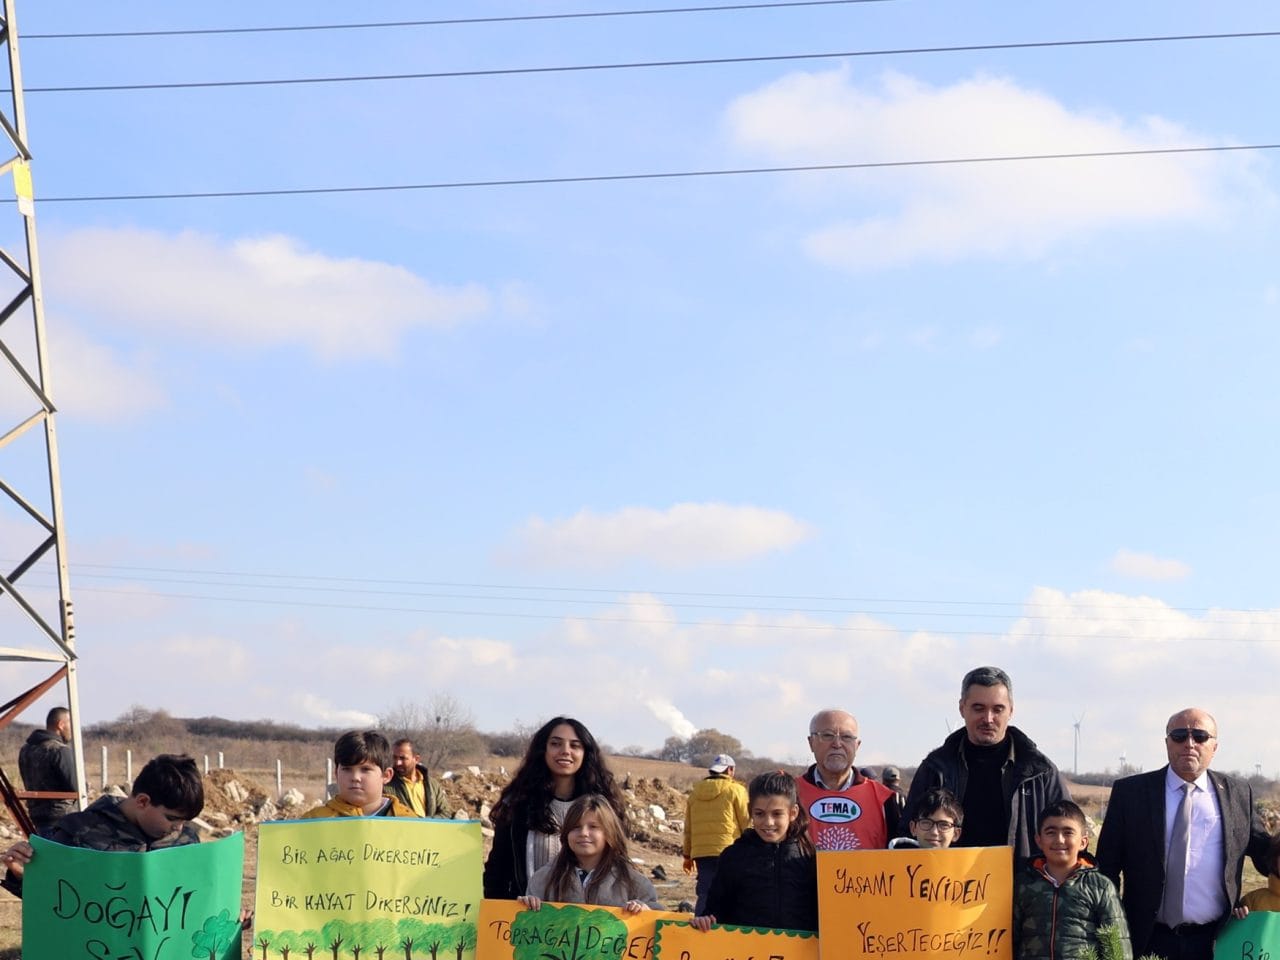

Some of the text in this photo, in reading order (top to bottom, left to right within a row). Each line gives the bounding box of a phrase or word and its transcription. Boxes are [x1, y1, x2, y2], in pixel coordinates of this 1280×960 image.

[820, 802, 850, 815] TEMA
[282, 845, 308, 865] BİR
[316, 847, 355, 866] AĞAÇ
[834, 864, 991, 905] YAŞAMI YENİDEN
[53, 879, 197, 937] DOĞAYI
[271, 890, 298, 909] BİR
[305, 892, 355, 911] HAYAT
[489, 920, 571, 949] TOPRAĞA
